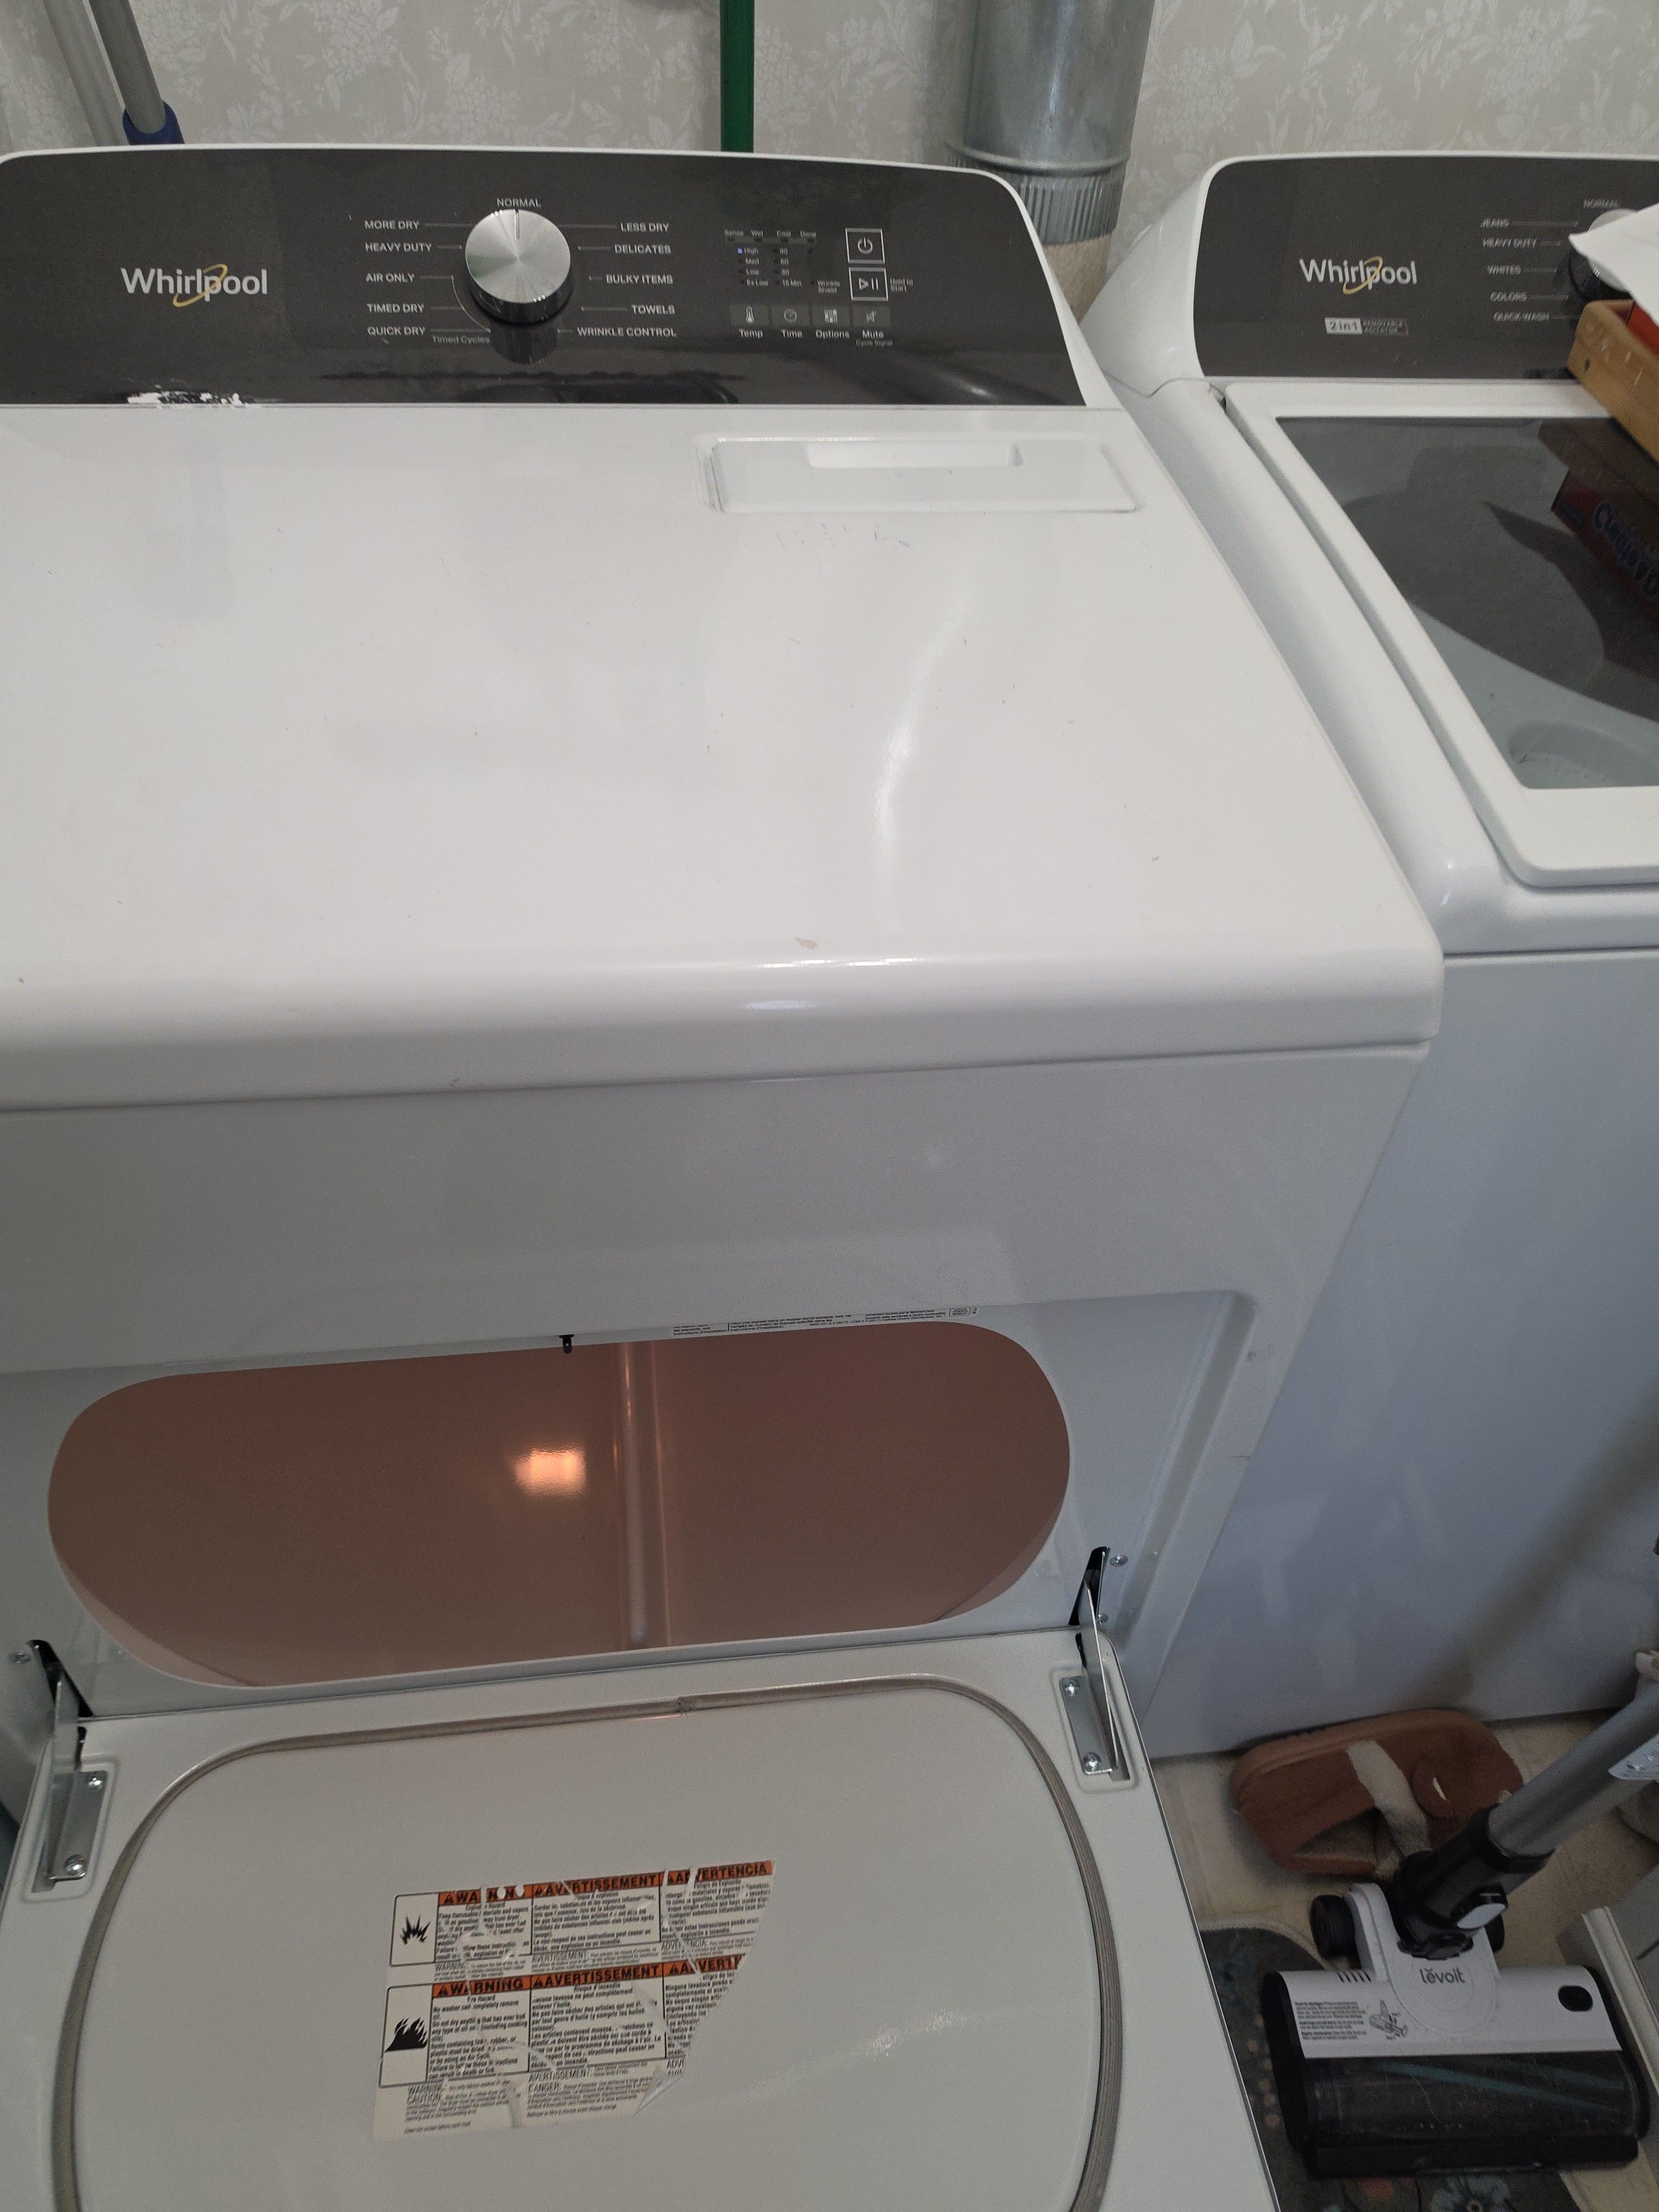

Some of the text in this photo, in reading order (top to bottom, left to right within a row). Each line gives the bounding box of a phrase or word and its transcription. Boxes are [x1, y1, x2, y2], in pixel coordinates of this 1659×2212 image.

[497, 198, 541, 207] NORMAL
[364, 221, 419, 229] MORE DRY
[621, 223, 669, 232] LESS DRY
[365, 243, 432, 252] HEAVY DUTY
[615, 245, 671, 254] DELICATES
[366, 274, 415, 282] AIR ONLY
[1300, 259, 1417, 290] Whirlpool
[606, 275, 673, 284] BULKY ITEMS
[121, 267, 268, 302] Whirlpool
[366, 304, 424, 313] TIMED DRY
[631, 305, 674, 314] TOWELS
[367, 326, 425, 336] QUICK DRY
[577, 327, 677, 337] WRINKLE CONTROL
[738, 329, 763, 339] Temp
[781, 330, 802, 338] Time
[815, 330, 850, 339] Options
[863, 330, 884, 339] Mute
[456, 1886, 525, 1904] WANN
[545, 1966, 659, 1986] AVERTISSEMENT
